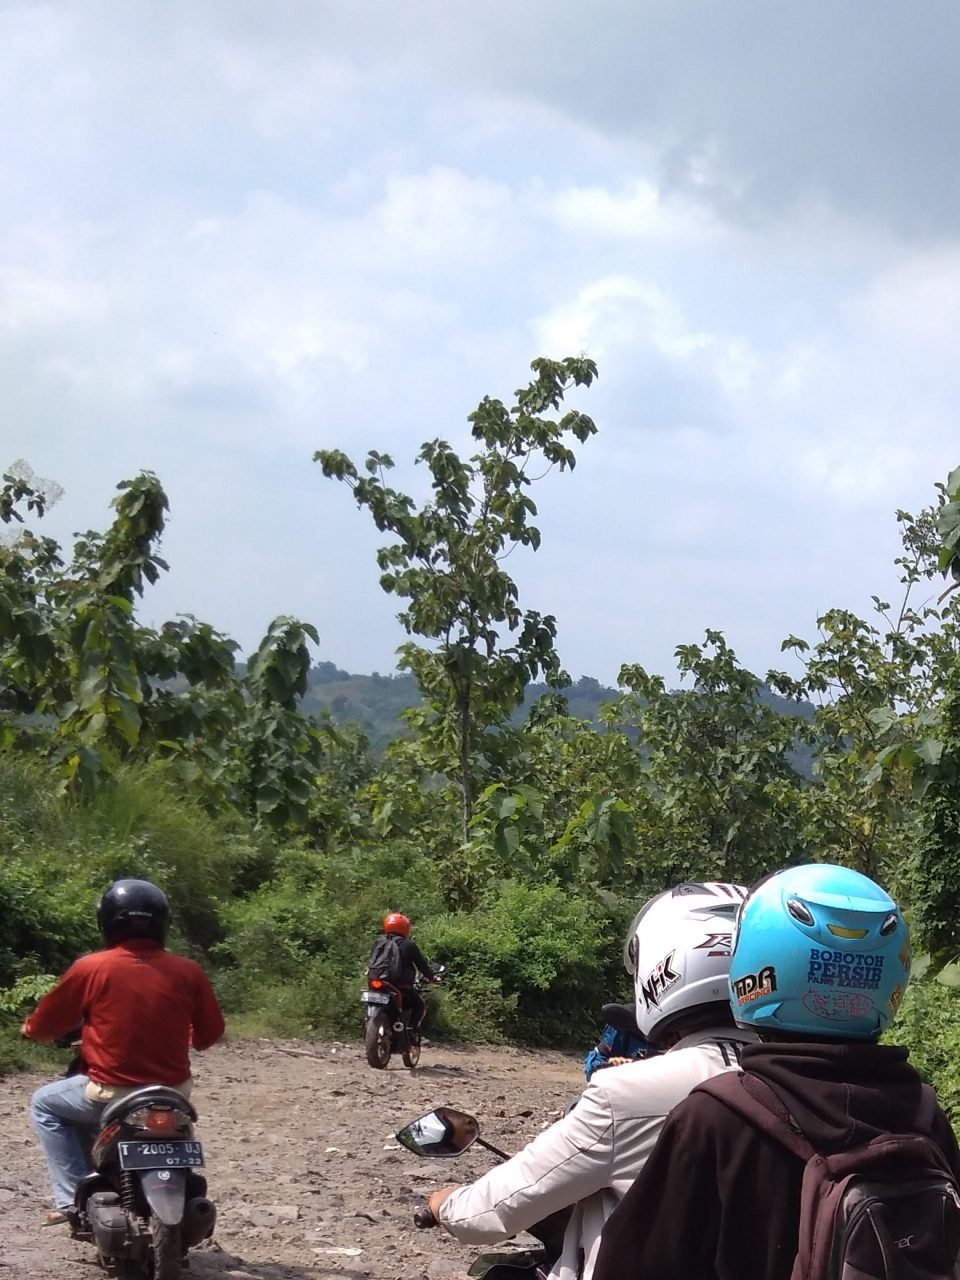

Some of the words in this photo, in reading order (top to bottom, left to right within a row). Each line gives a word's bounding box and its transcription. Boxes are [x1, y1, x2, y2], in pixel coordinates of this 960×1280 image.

[809, 948, 884, 967] BOBOTOH
[640, 950, 681, 1013] NHK
[808, 960, 882, 983] PERSIB
[121, 1144, 129, 1156] T
[184, 1143, 201, 1154] UJ
